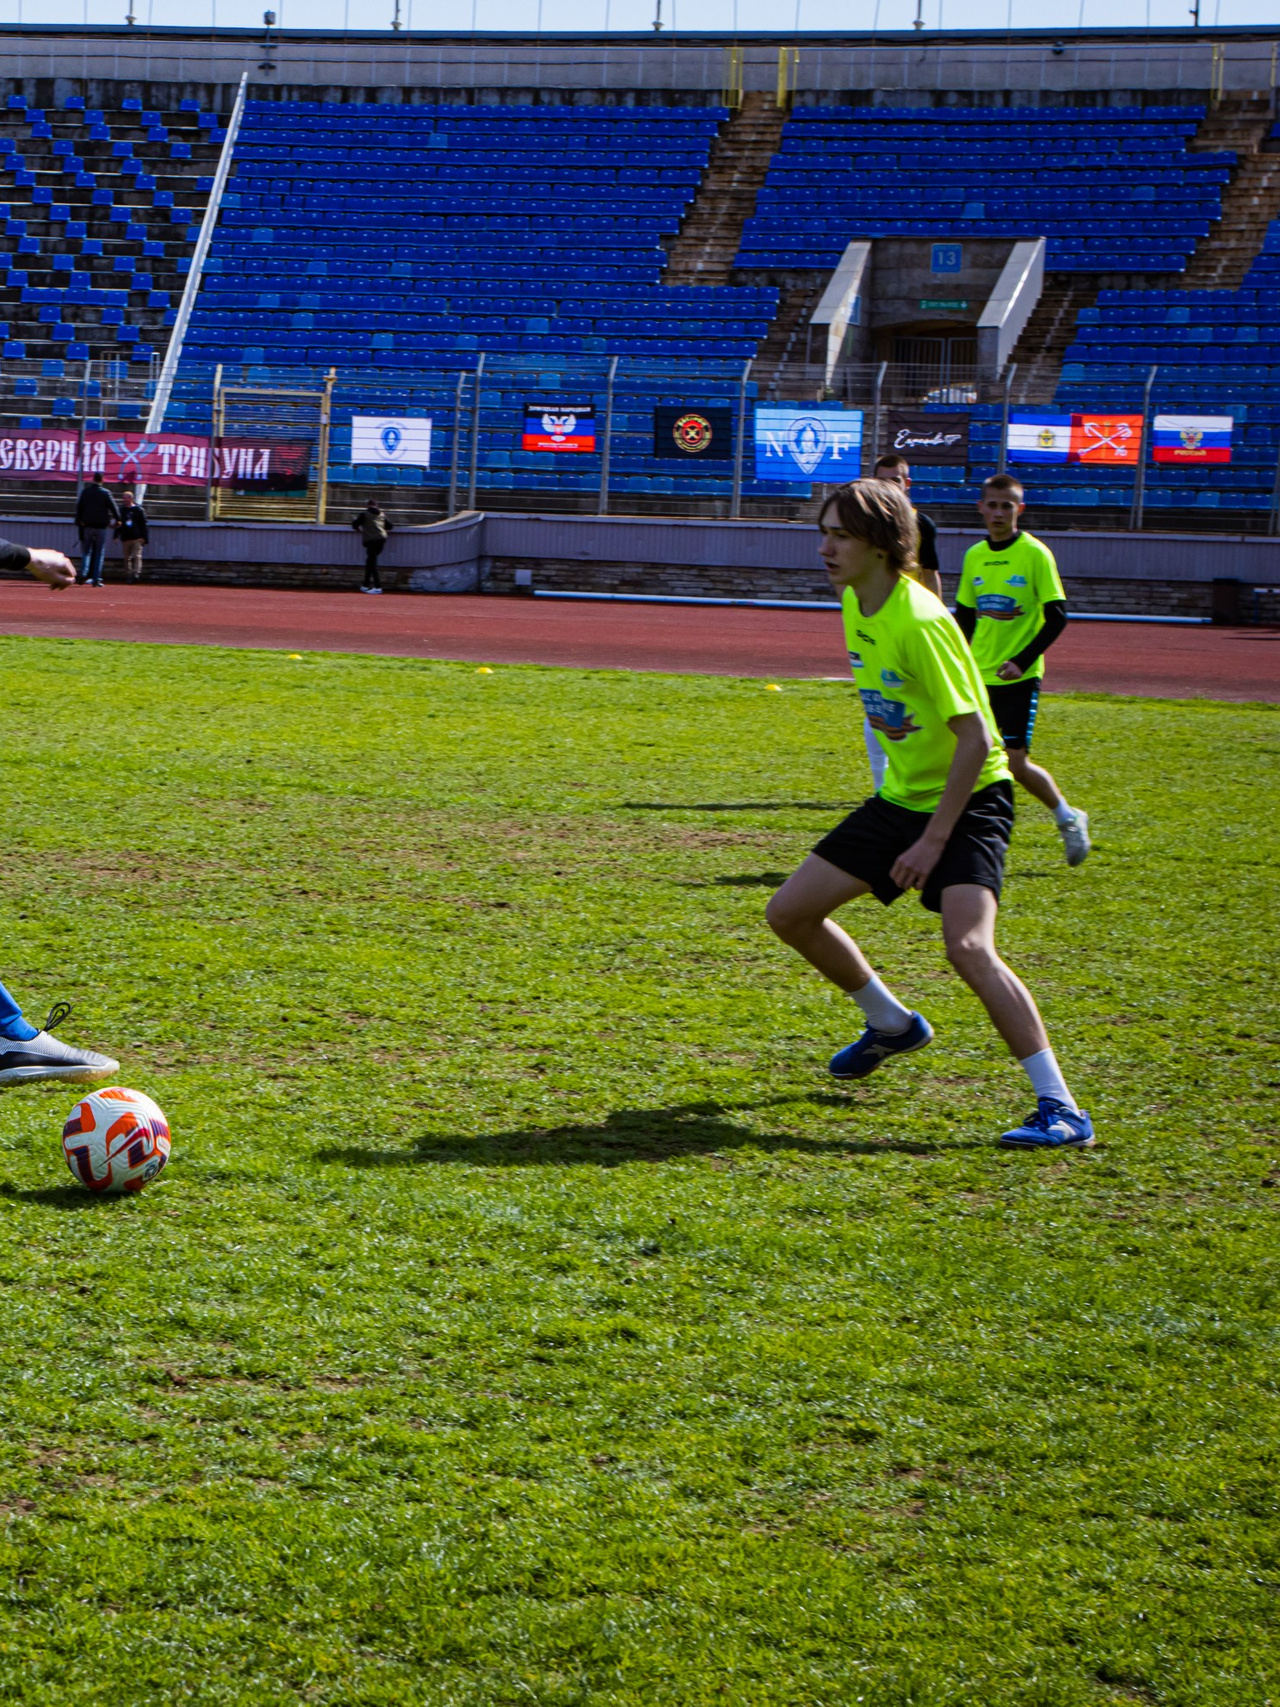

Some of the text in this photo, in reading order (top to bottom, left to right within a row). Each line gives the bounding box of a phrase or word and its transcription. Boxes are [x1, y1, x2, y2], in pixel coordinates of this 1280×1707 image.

[937, 251, 957, 266] 13
[764, 431, 851, 460] N F
